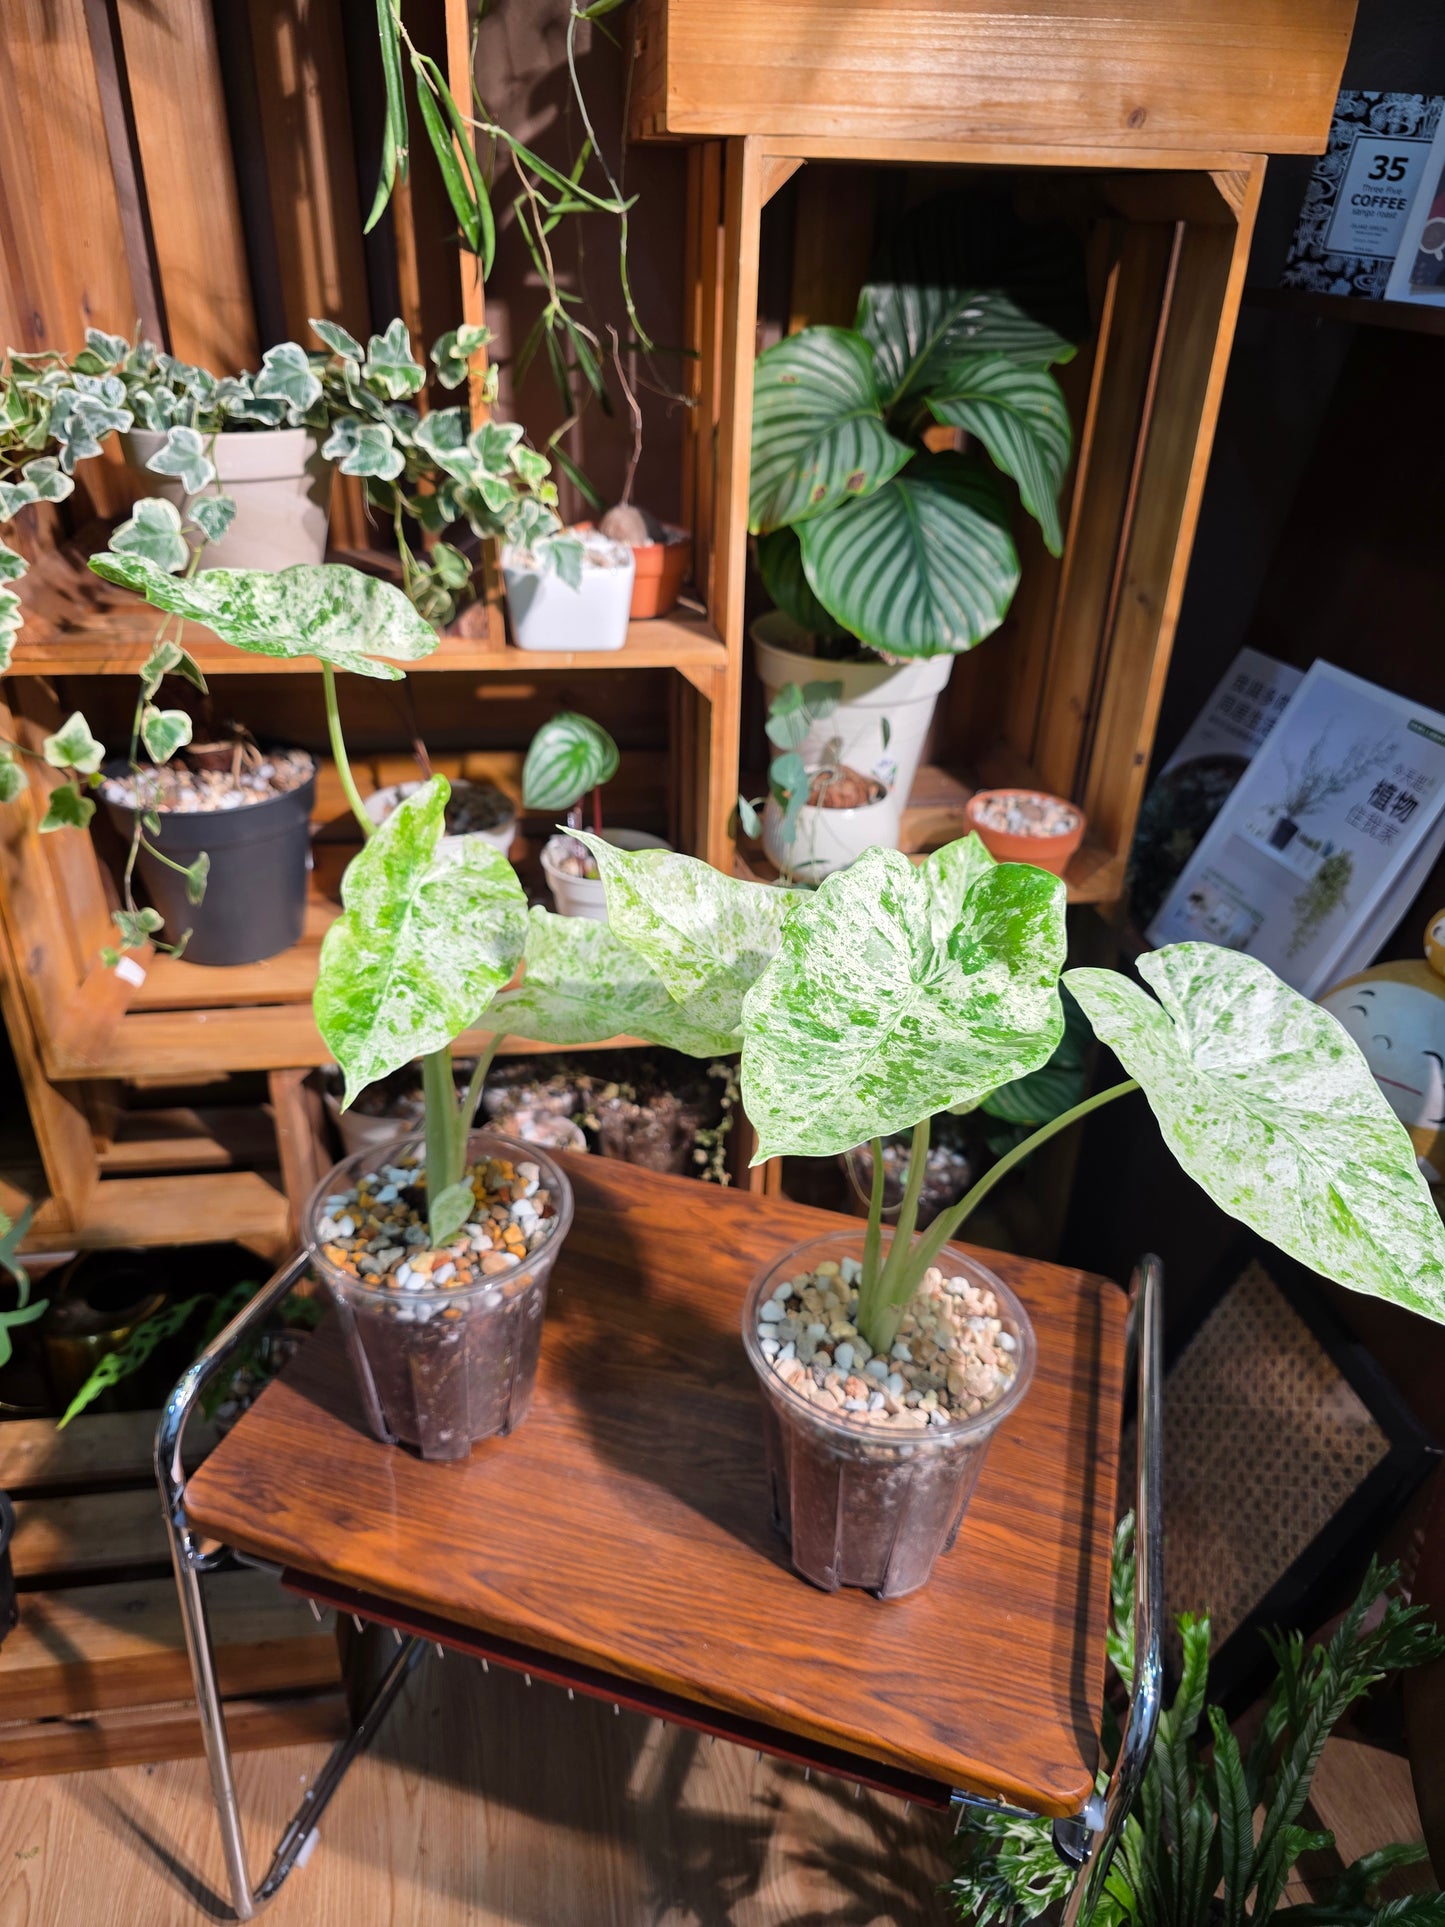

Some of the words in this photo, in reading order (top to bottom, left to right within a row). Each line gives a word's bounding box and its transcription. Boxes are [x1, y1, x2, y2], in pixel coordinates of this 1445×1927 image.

[1367, 154, 1409, 182] 35
[1351, 193, 1407, 211] COFFEE
[1366, 777, 1419, 823] 植物
